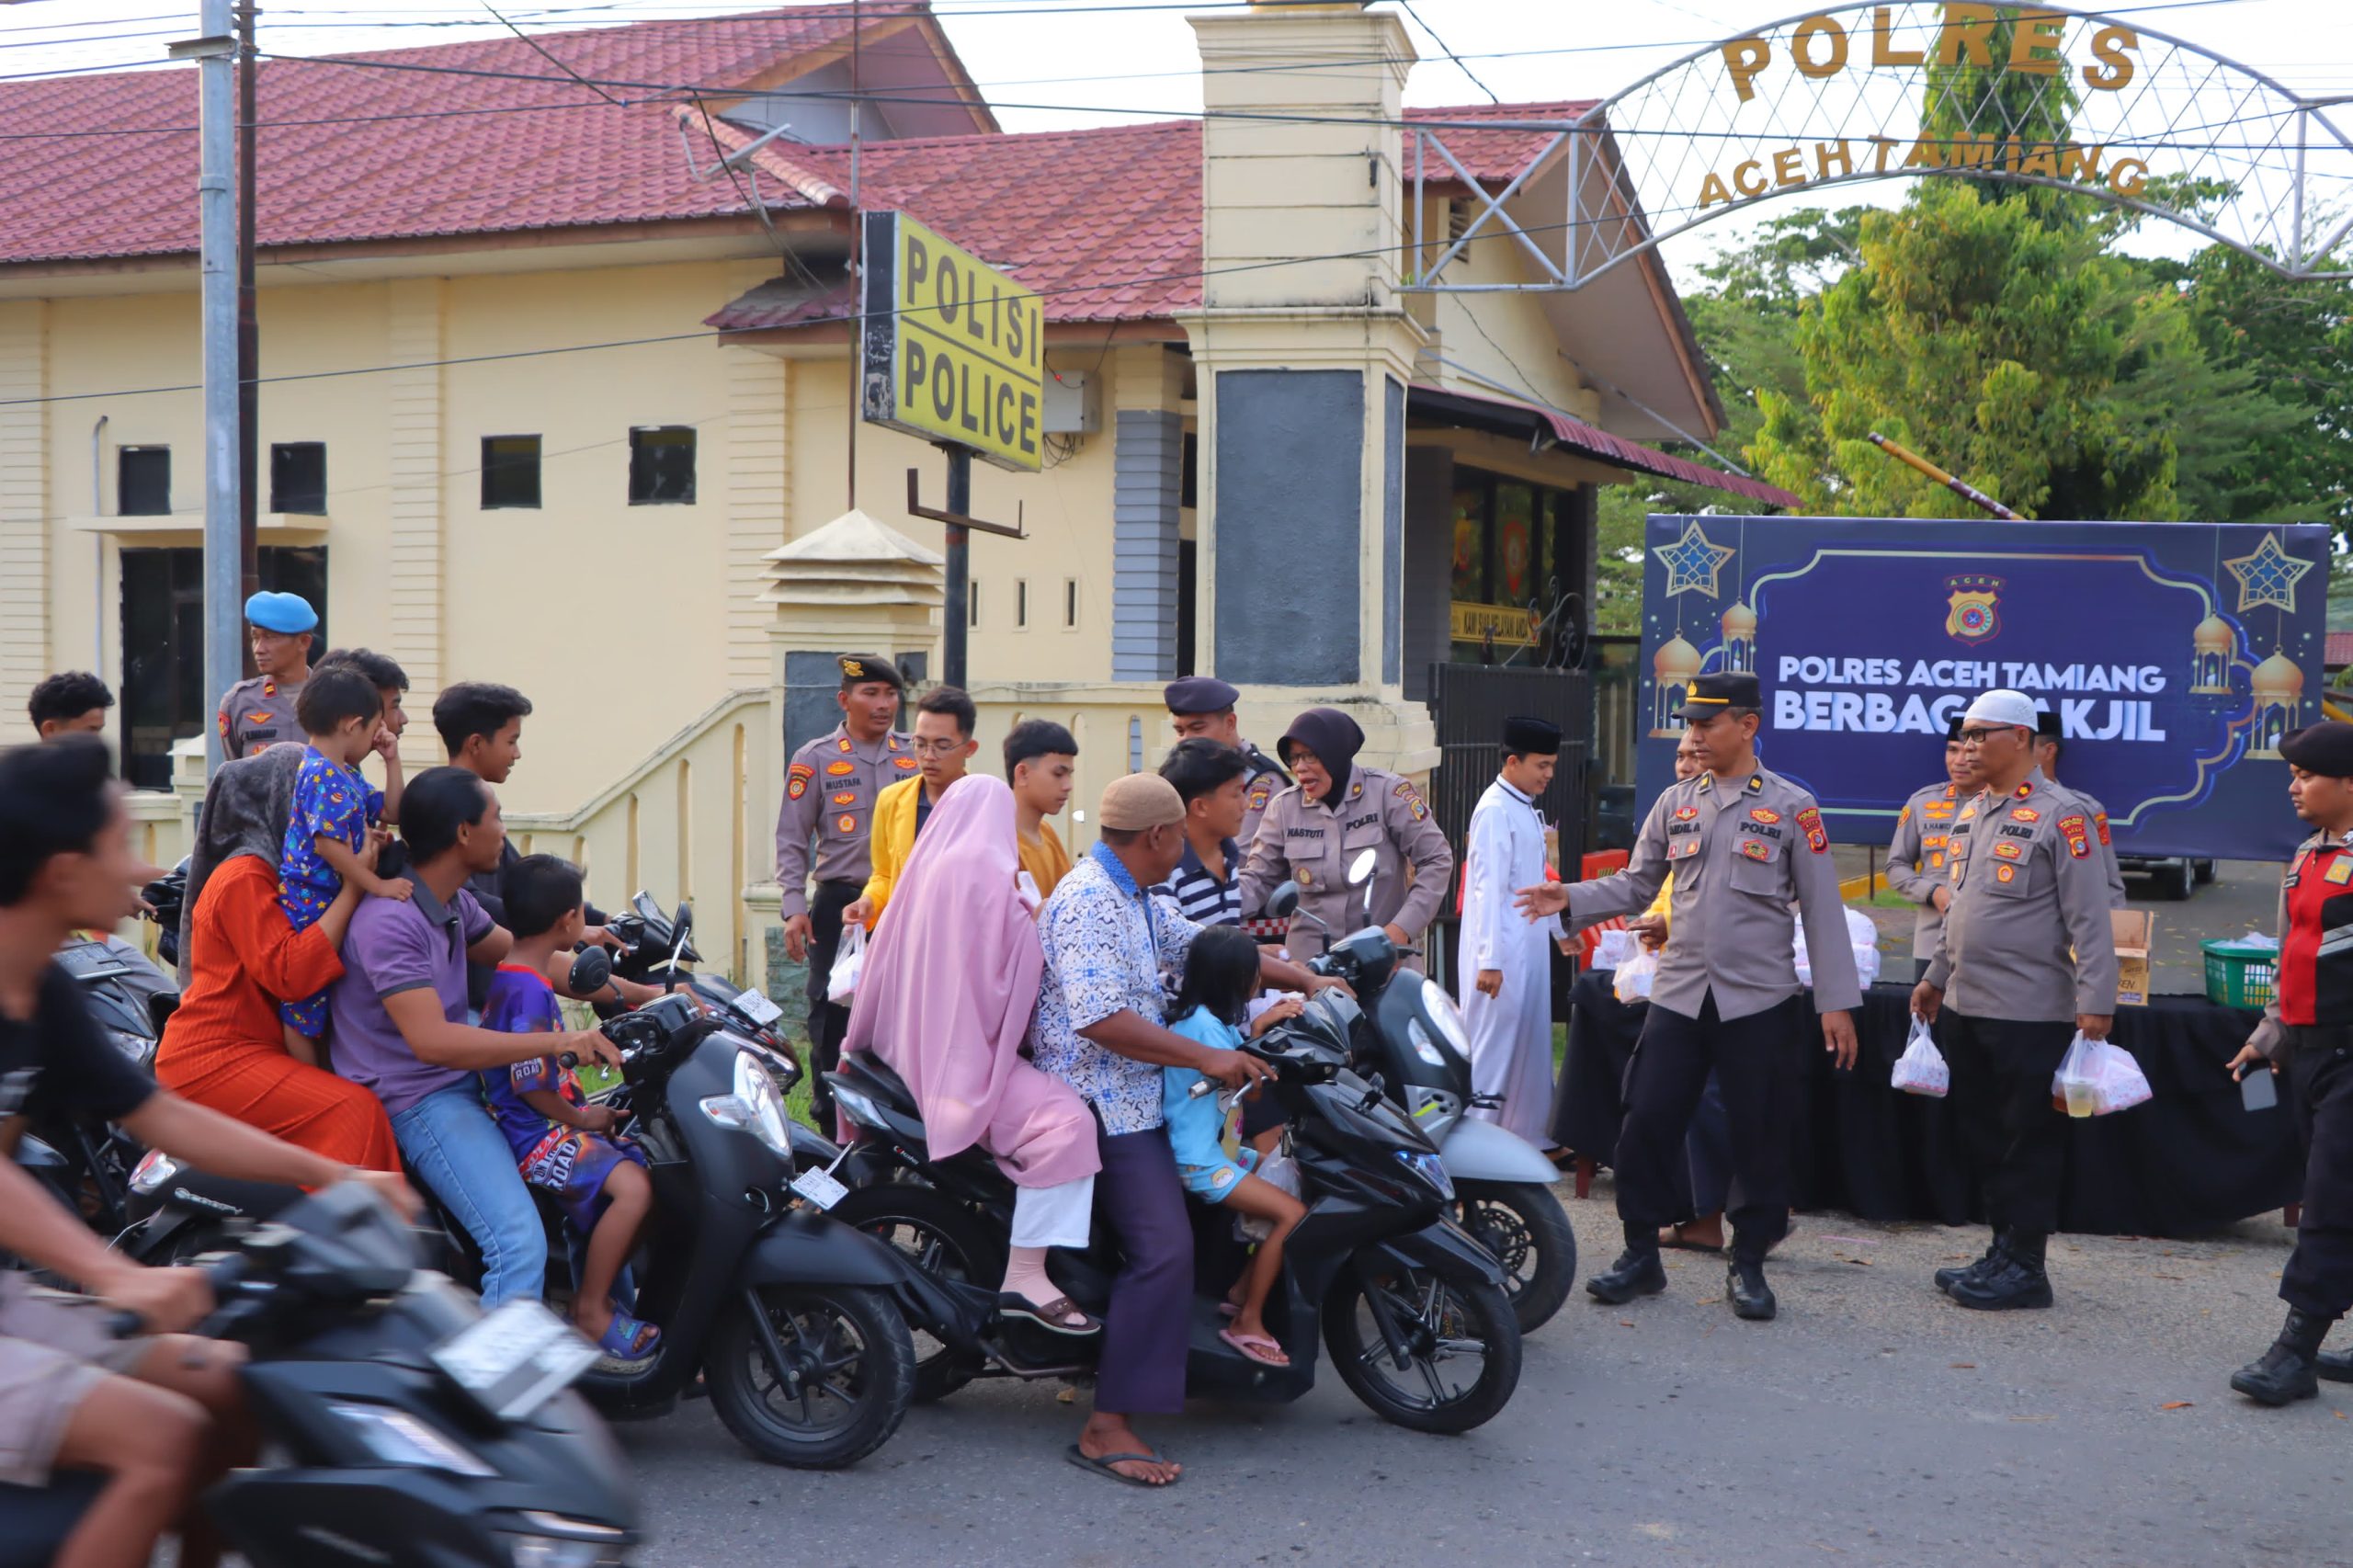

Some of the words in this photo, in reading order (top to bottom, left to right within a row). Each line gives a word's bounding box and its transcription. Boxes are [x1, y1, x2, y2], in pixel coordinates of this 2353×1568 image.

[1722, 3, 2139, 103] POLRES
[1699, 140, 1852, 210] ACEH
[1867, 131, 2150, 198] TAMIANG
[906, 233, 1038, 369] POLISI
[904, 337, 1037, 455] POLICE
[1950, 576, 2000, 586] ACEH
[1779, 655, 1902, 686] POLRES
[1906, 660, 1996, 688] ACEH
[2001, 661, 2167, 694] TAMIANG
[1773, 688, 1979, 735] BERBAG
[826, 778, 862, 790] MUSTAFA
[1346, 812, 1379, 832] POLRI
[1740, 822, 1782, 840] POLRI
[1999, 824, 2034, 840] POLRI
